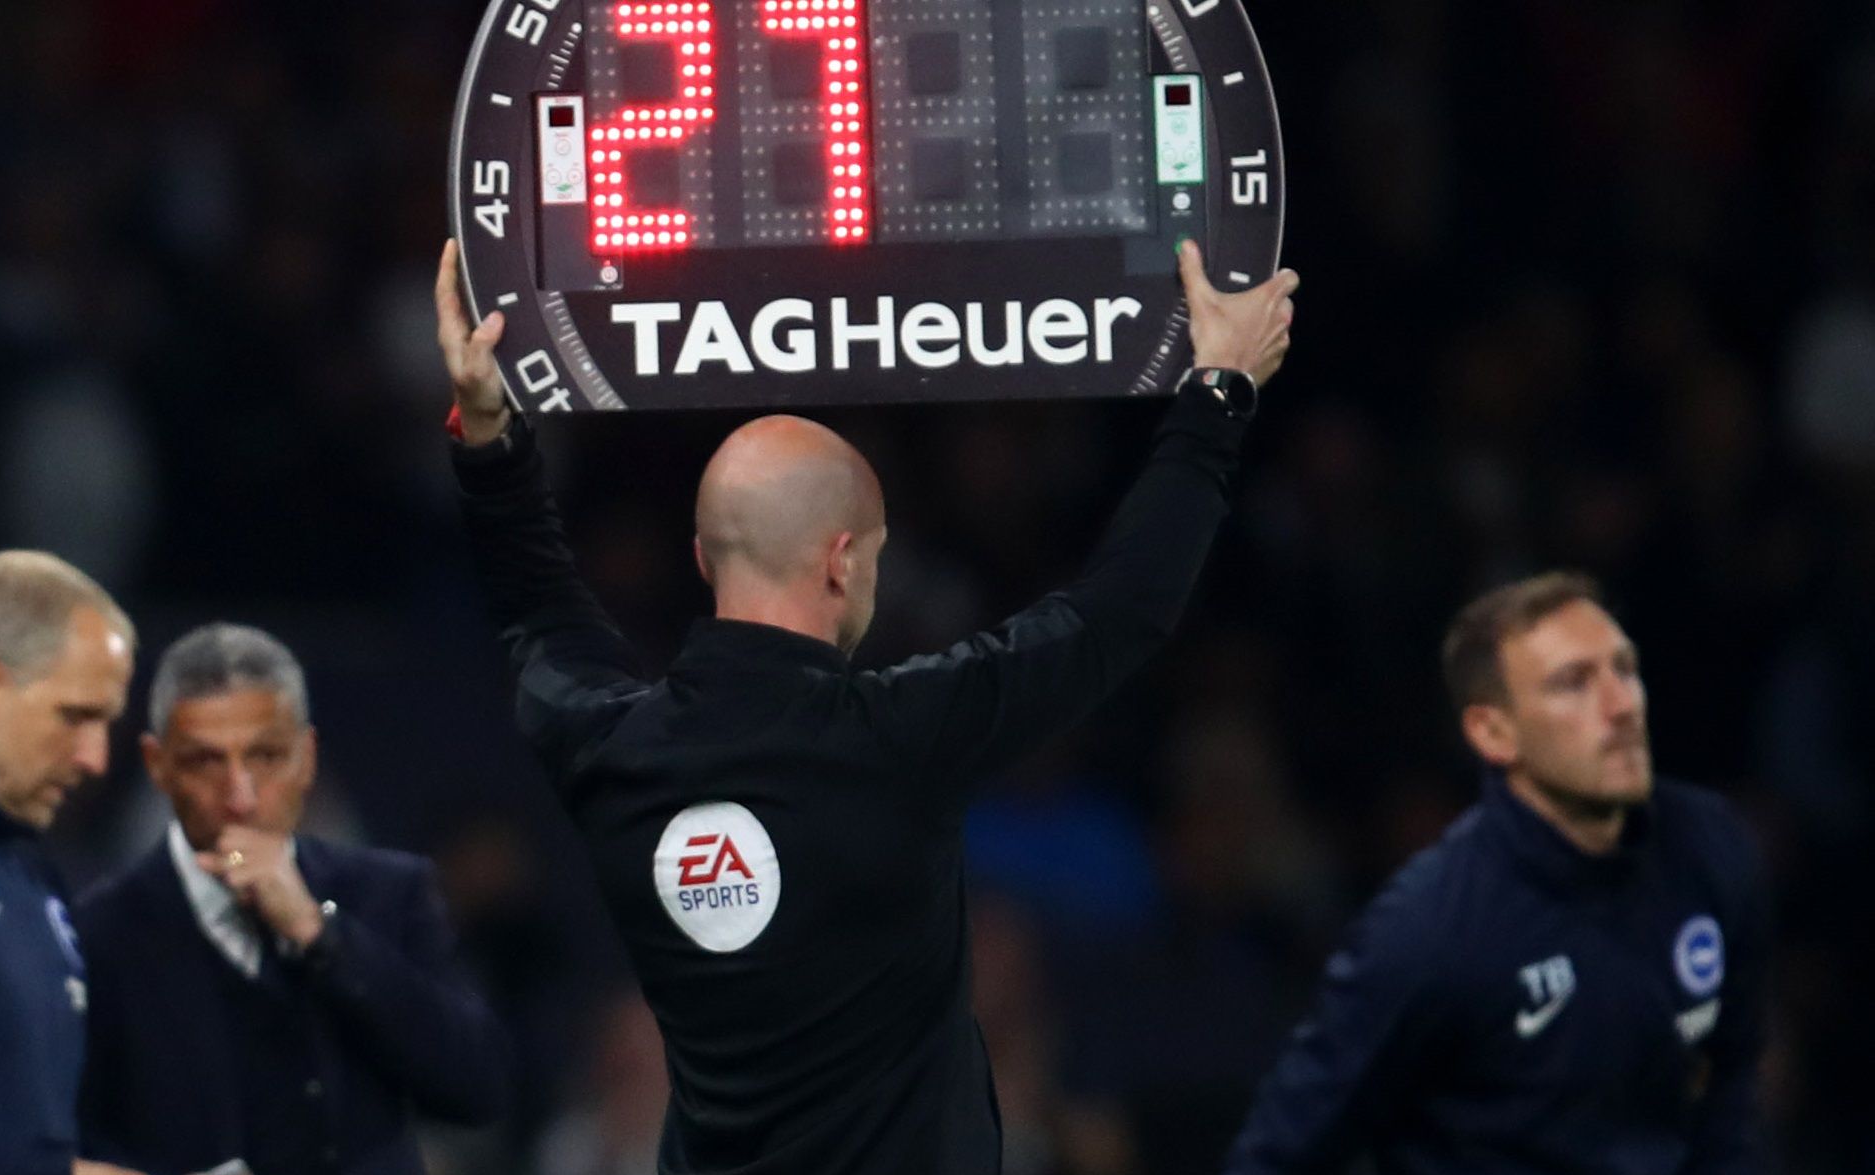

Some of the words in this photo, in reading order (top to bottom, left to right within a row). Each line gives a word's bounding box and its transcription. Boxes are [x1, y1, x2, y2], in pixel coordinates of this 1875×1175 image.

[505, 0, 560, 46] 5
[589, 0, 865, 250] 27
[473, 160, 510, 238] 45
[1230, 149, 1268, 206] 15
[678, 833, 755, 886] EA
[678, 883, 760, 911] SPORTS
